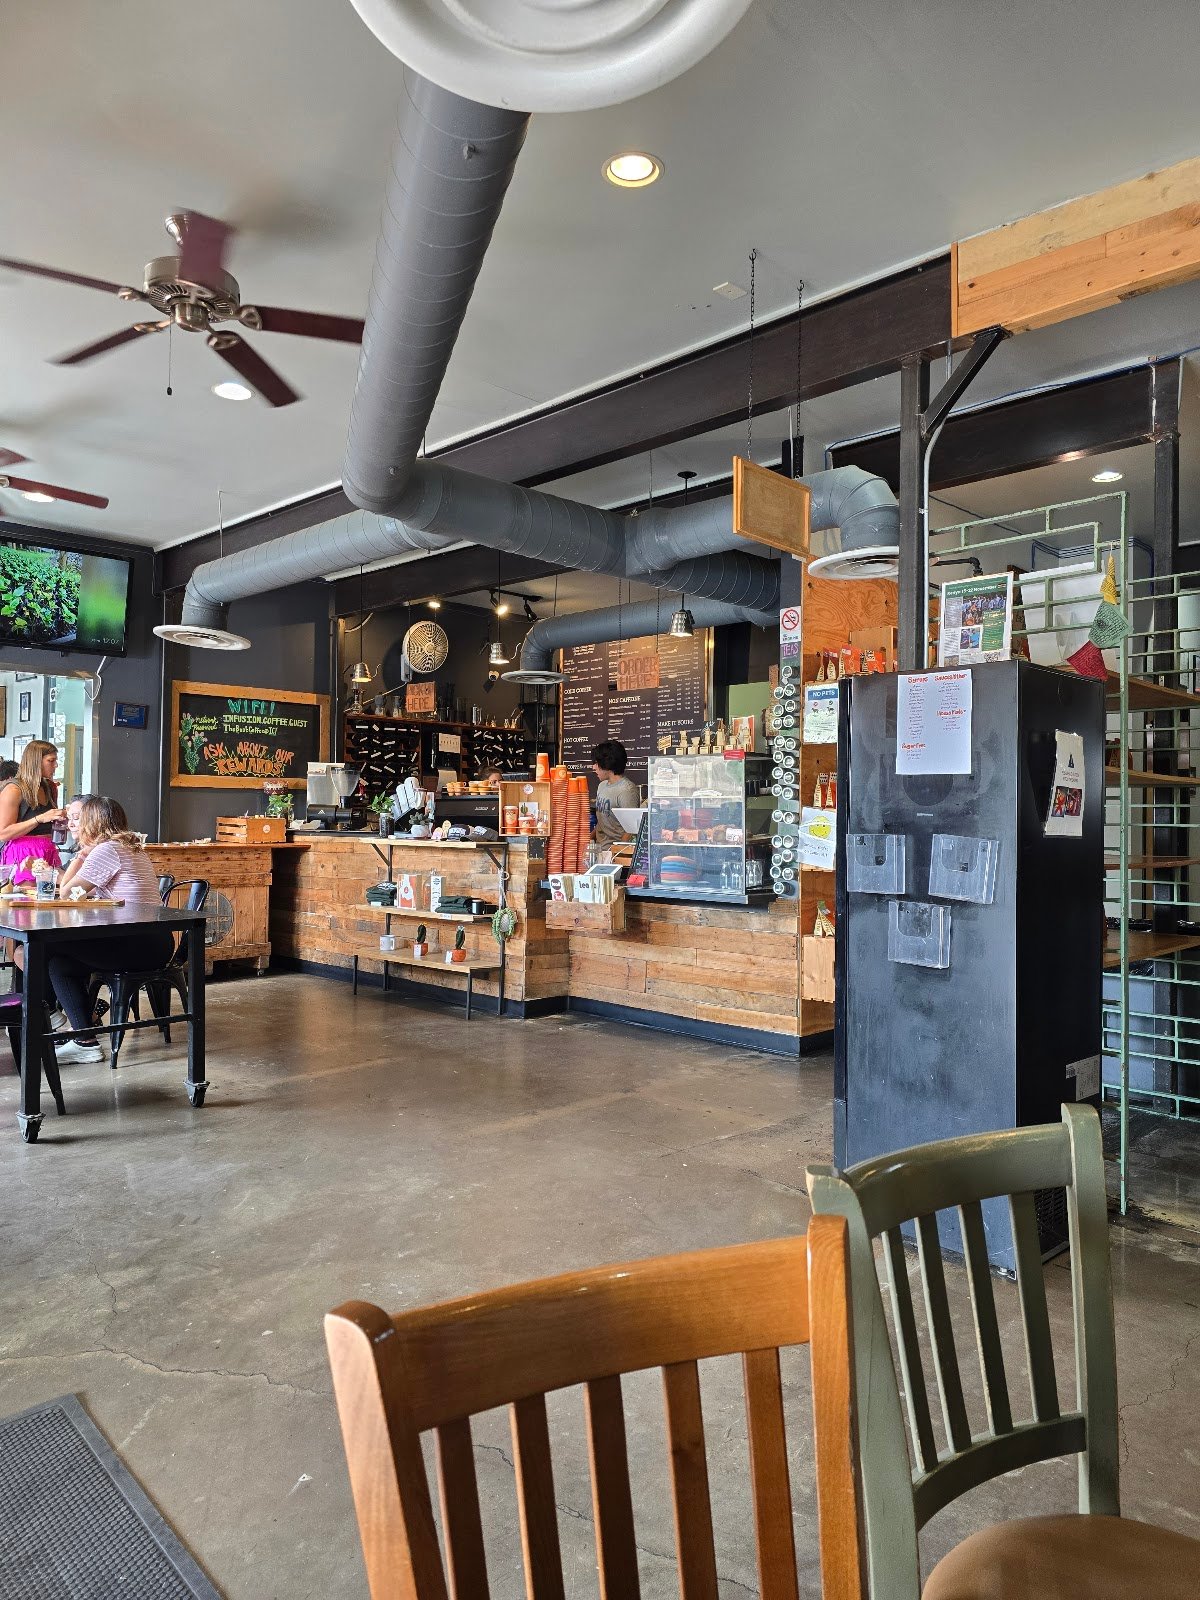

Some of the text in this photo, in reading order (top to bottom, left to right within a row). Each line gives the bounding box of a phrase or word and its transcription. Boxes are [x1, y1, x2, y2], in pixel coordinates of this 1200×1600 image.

[781, 643, 799, 656] TEAS
[812, 689, 836, 698] NO PETS
[203, 741, 294, 765] ASK ABOUT OUR
[216, 757, 283, 774] REWARDS
